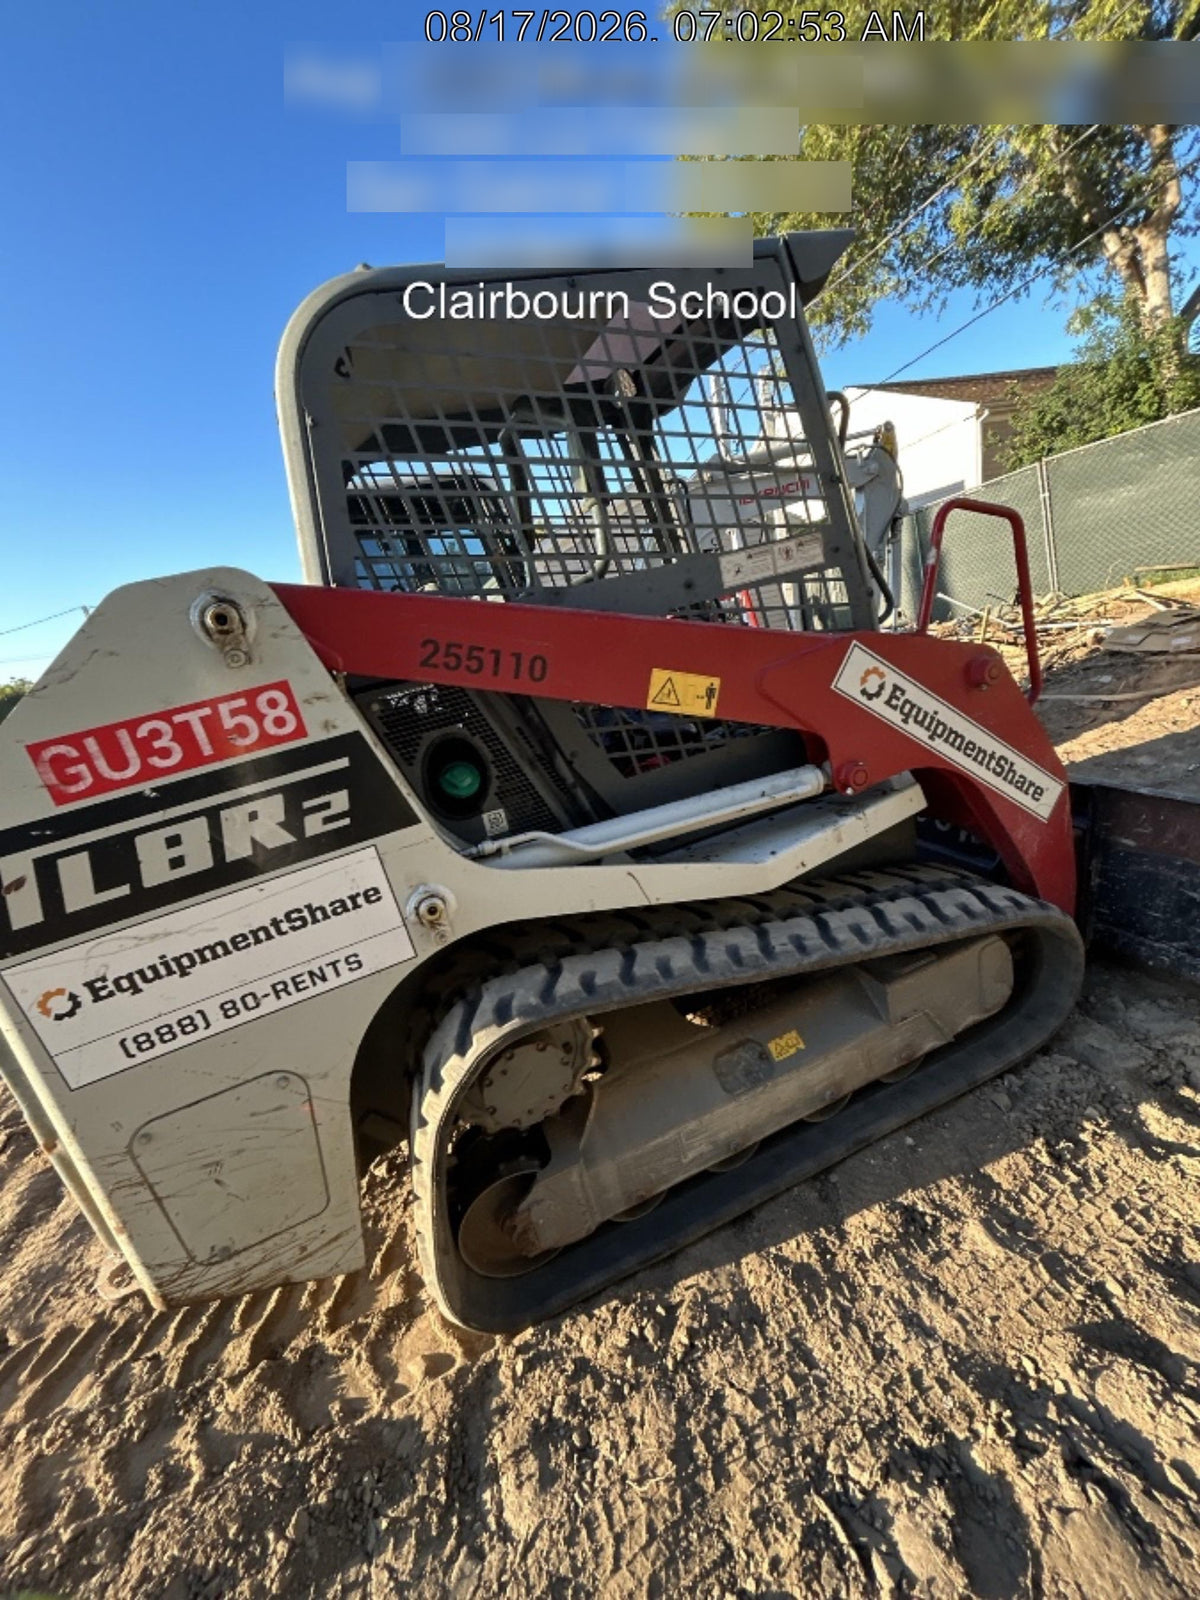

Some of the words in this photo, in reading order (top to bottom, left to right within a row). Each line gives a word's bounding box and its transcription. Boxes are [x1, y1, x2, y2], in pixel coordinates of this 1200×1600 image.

[739, 478, 810, 505] EUCHI
[419, 638, 547, 682] 255110
[37, 689, 298, 794] GU3T58
[884, 683, 1044, 802] EquipmentShare
[83, 886, 383, 1004] EquipmentShare
[119, 1010, 212, 1059] (888)
[222, 952, 364, 1021] 80-RENTS
